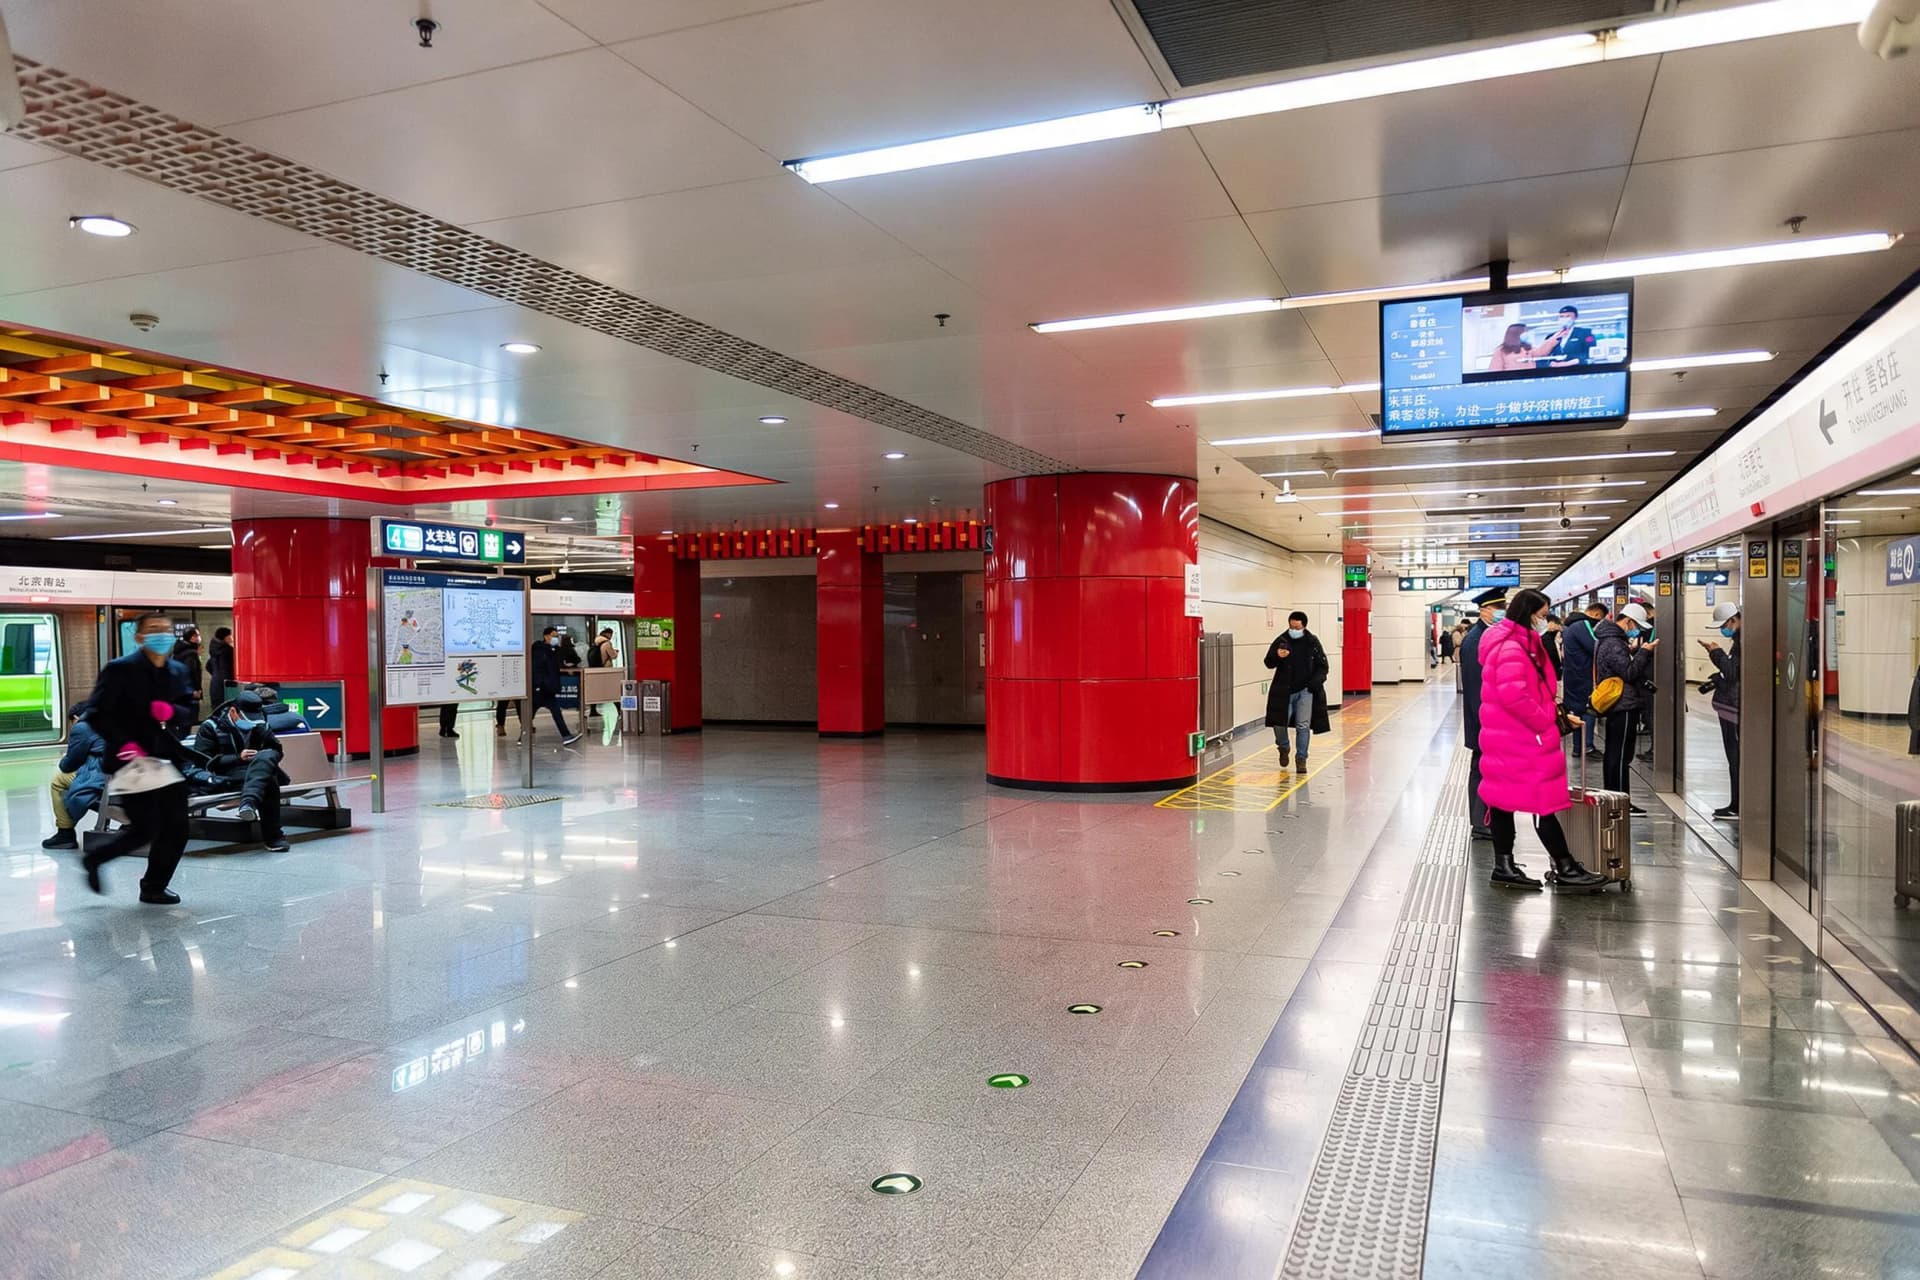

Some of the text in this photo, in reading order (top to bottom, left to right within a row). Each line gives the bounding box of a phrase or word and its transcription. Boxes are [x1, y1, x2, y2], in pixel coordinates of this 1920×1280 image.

[425, 528, 457, 545] 火车站
[18, 576, 66, 588] 北京南站
